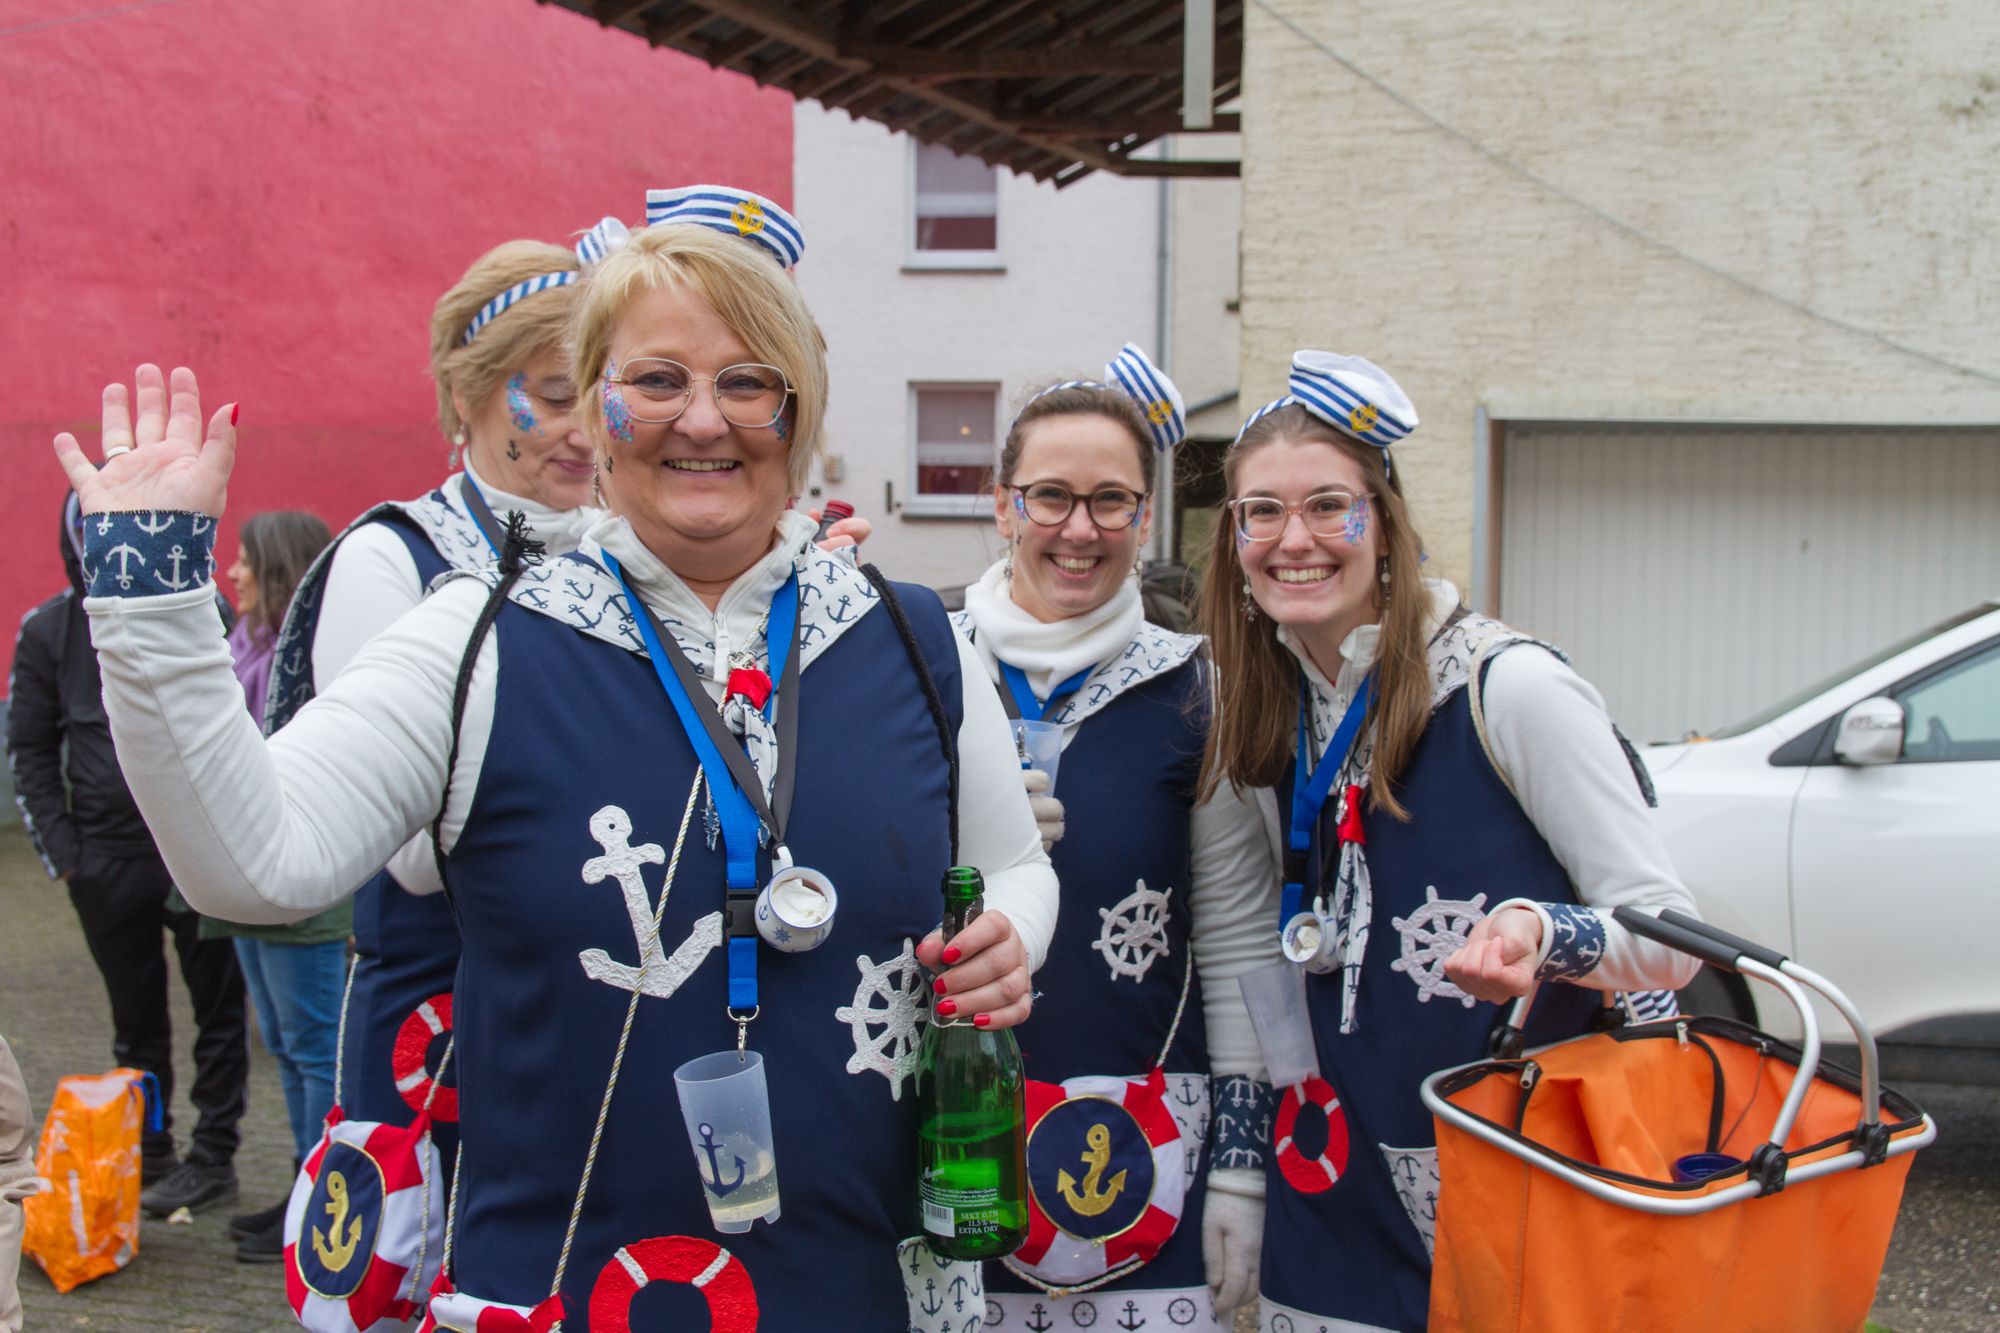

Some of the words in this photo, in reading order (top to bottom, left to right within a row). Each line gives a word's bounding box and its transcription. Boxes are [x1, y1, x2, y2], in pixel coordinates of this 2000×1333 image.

[961, 1211, 980, 1220] SEKT
[958, 1226, 982, 1235] EXTRA
[983, 1225, 998, 1233] DRY
